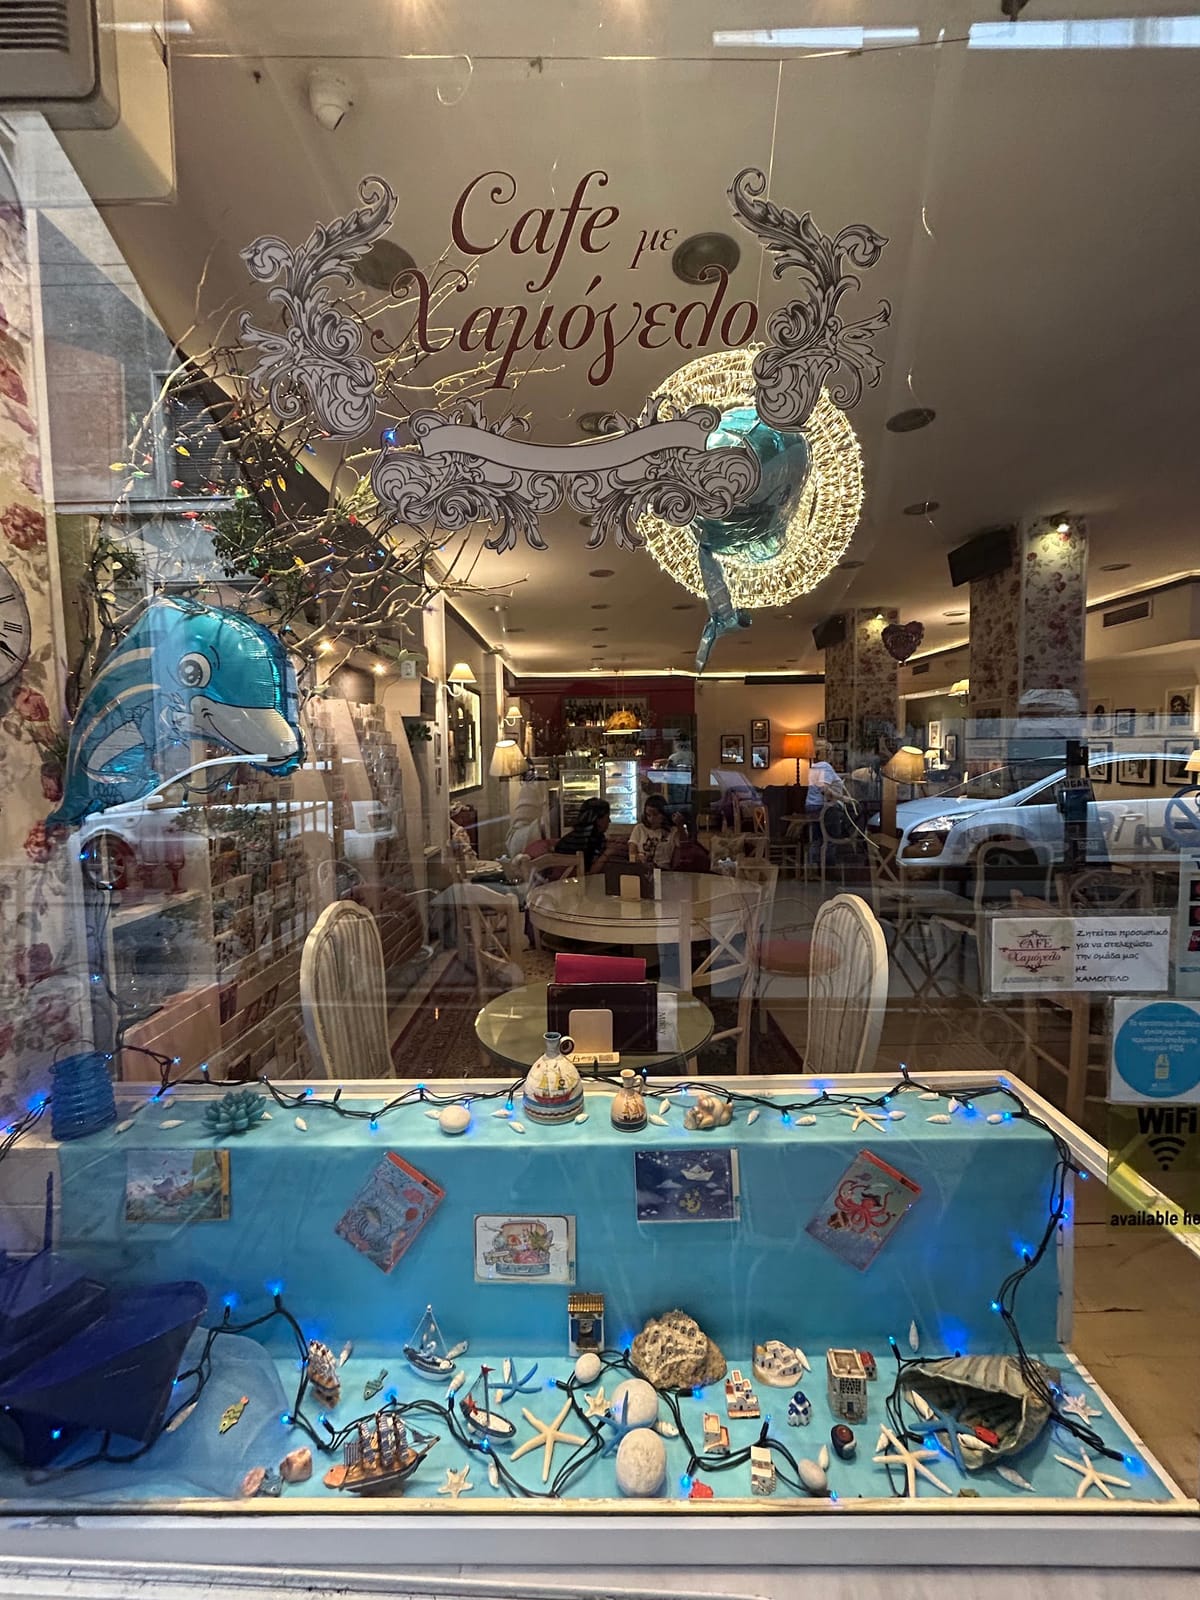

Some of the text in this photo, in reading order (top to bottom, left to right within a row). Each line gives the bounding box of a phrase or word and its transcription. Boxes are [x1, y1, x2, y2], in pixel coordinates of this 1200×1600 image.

[451, 170, 678, 292] Cafe με
[370, 264, 758, 390] Χαμόγελο
[1076, 928, 1168, 938] Ζητείται προσωπικό
[1017, 938, 1052, 948] CAFE
[1076, 942, 1089, 950] για
[1093, 951, 1120, 960] ομάδα
[1122, 952, 1139, 960] μας
[1075, 965, 1088, 973] με
[1074, 975, 1129, 983] ΧΑΜΟΓΕΛΟ
[1137, 1107, 1198, 1134] WiFi
[1110, 1210, 1178, 1226] available
